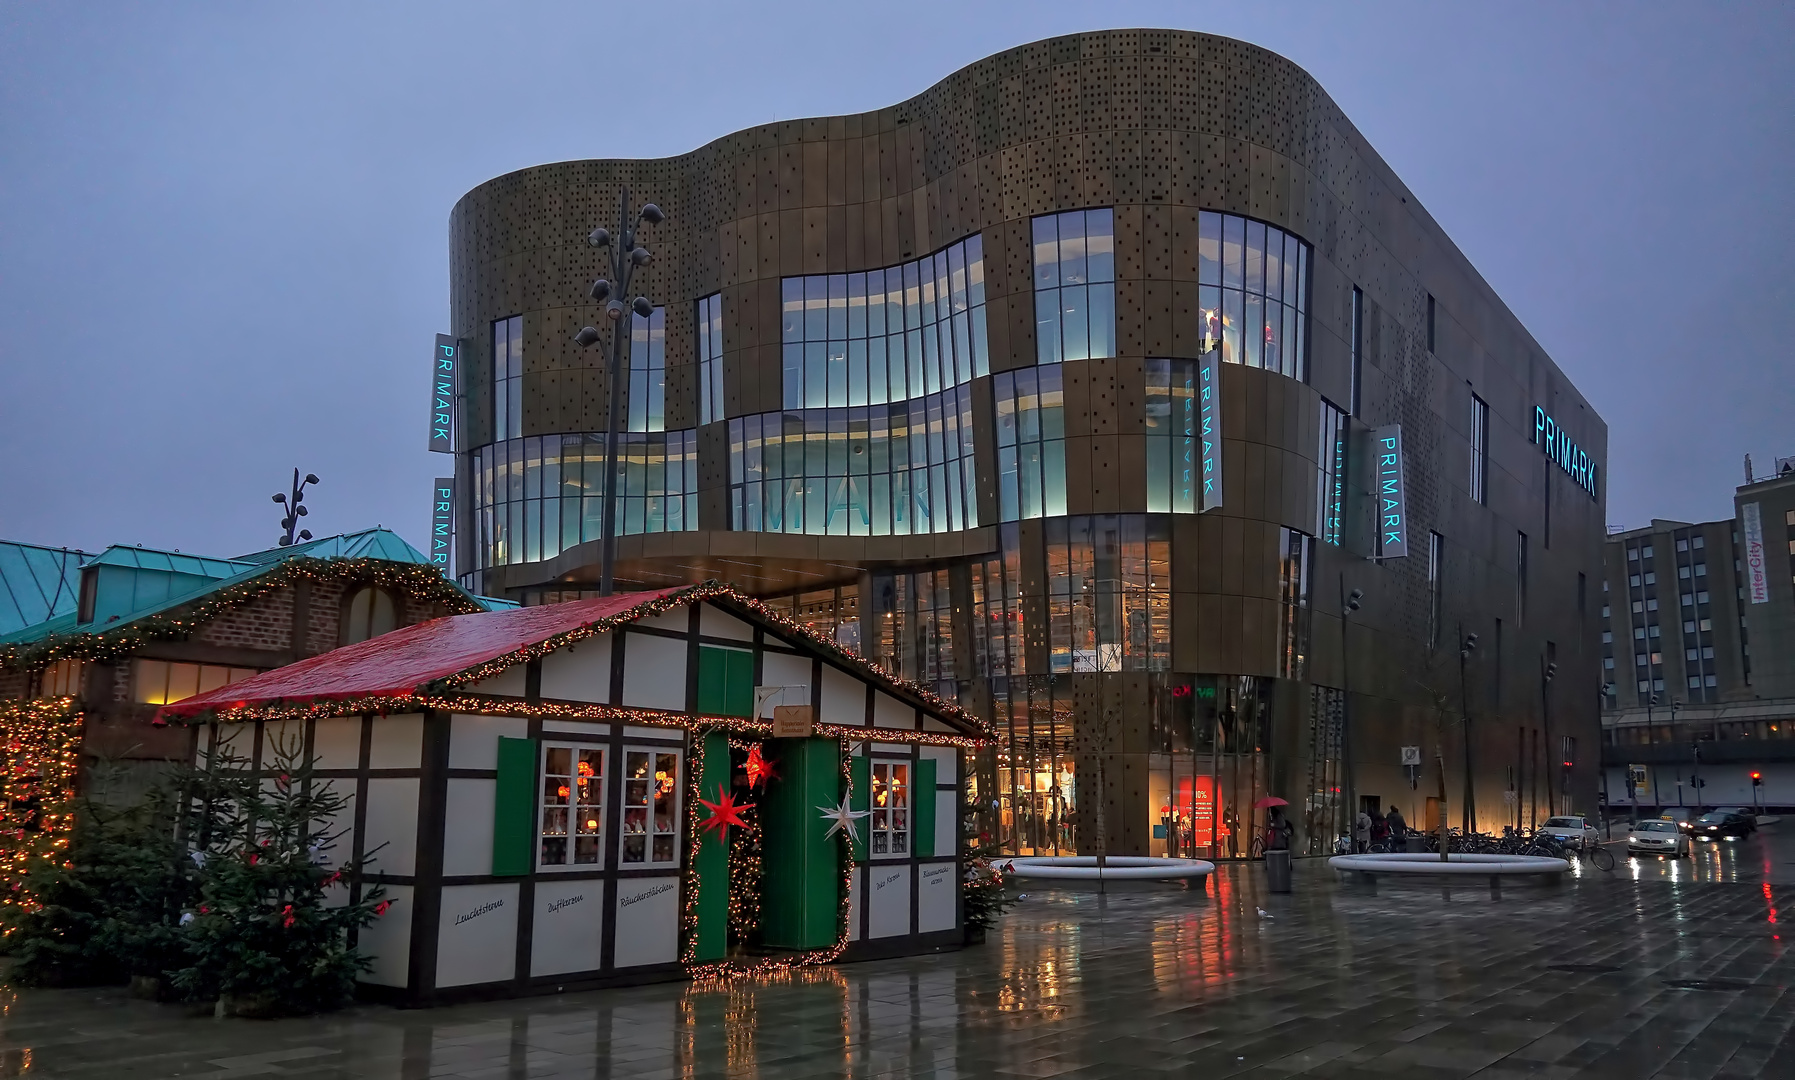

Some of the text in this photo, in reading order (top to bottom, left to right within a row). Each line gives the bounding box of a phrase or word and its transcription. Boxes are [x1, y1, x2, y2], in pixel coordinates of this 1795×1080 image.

[434, 344, 454, 440] PRIMARK
[1201, 366, 1214, 495] PRIMARK
[1380, 437, 1401, 545] PRIMARK
[1536, 405, 1595, 497] PRIMARK
[454, 899, 504, 926] Leuchtsterne
[547, 894, 584, 913] Duftkerzen
[620, 883, 674, 908] Räucherstäbchen
